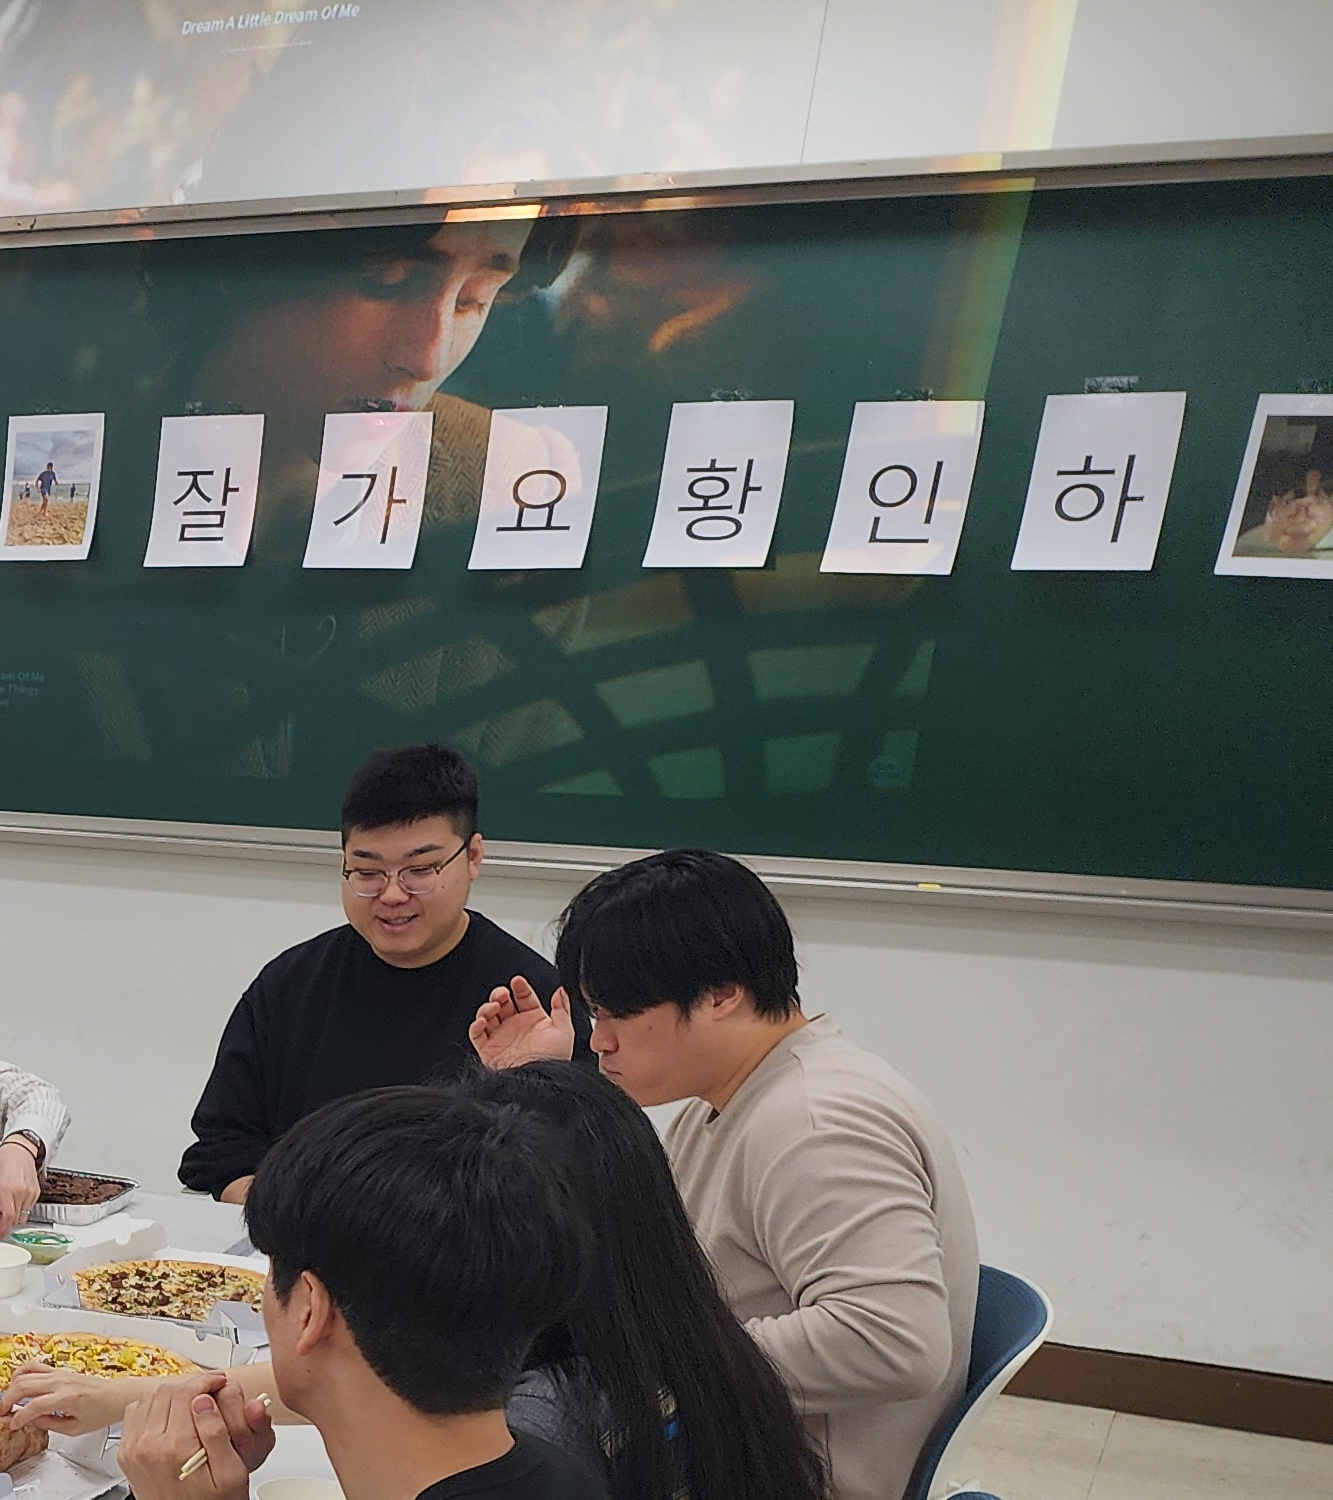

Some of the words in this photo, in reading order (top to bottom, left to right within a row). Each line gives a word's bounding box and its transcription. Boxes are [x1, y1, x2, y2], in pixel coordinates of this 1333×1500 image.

[181, 17, 226, 35] Dream
[225, 16, 235, 30] A
[237, 12, 270, 29] Little
[274, 8, 318, 25] Dream
[321, 5, 337, 20] Of
[338, 3, 361, 18] Me
